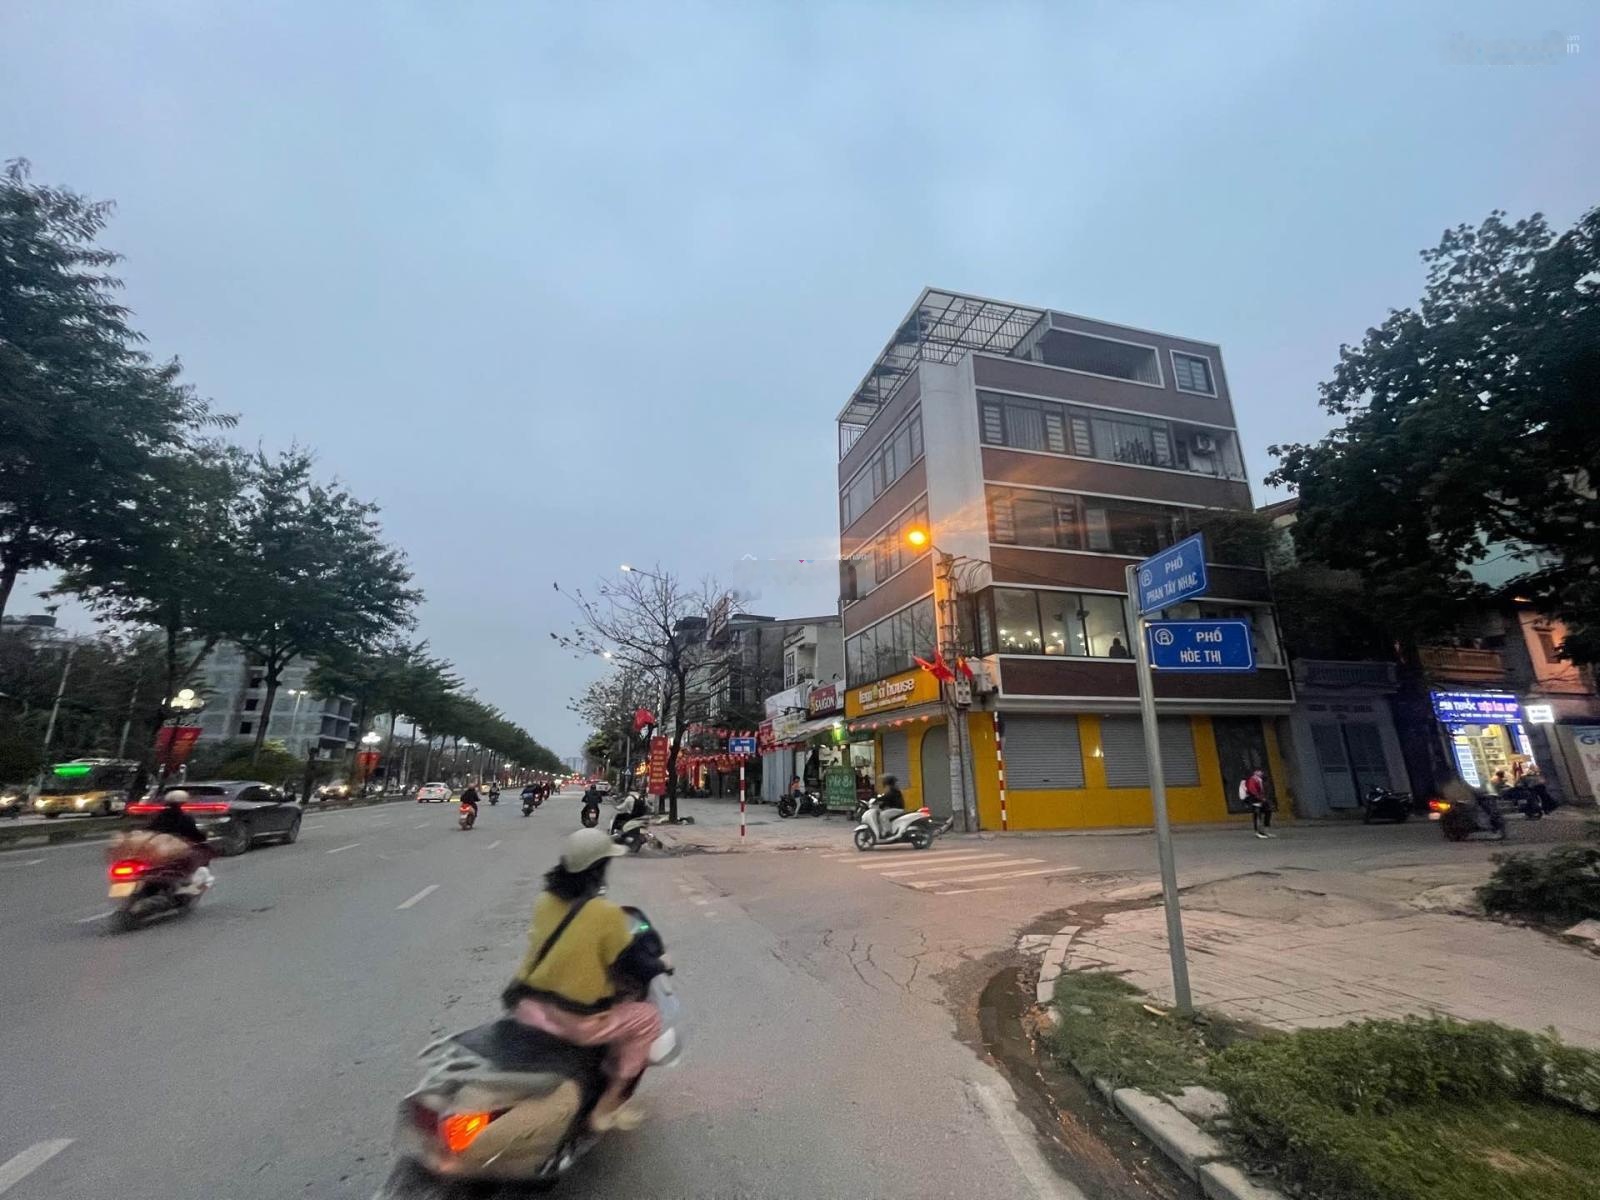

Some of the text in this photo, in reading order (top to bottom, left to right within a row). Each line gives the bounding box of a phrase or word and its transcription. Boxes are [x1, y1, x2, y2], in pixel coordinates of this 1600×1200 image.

[1165, 553, 1183, 574] PHỐ
[1146, 587, 1163, 604] PHAN
[1178, 572, 1198, 589] NHẠC
[1196, 627, 1223, 643] PHỐ
[1204, 649, 1222, 665] THỊ
[886, 678, 914, 695] house
